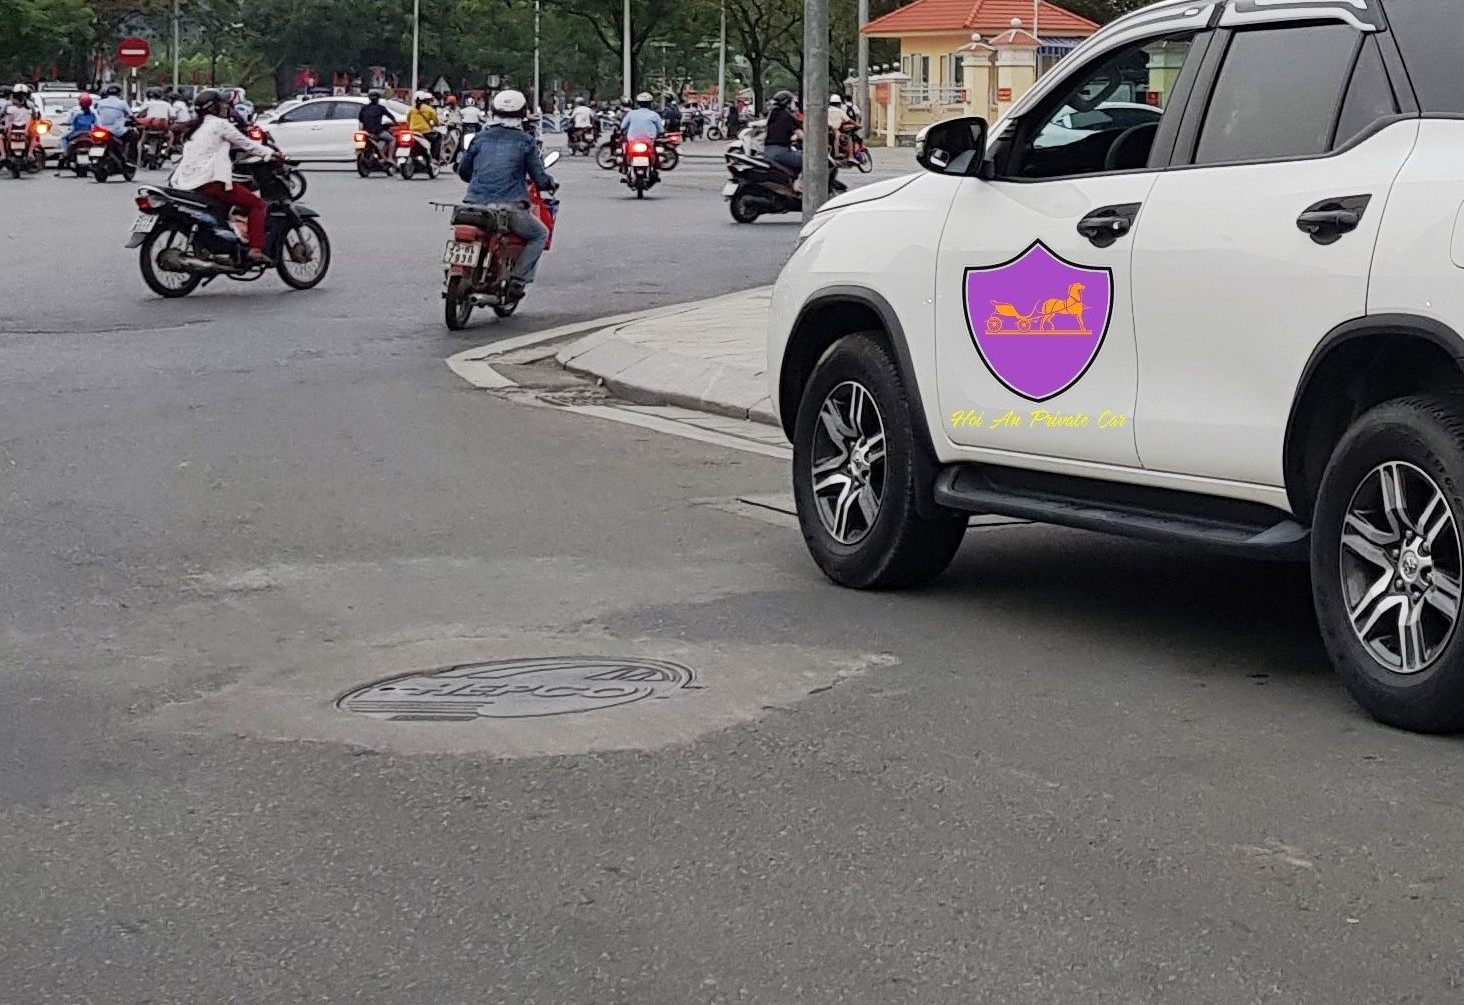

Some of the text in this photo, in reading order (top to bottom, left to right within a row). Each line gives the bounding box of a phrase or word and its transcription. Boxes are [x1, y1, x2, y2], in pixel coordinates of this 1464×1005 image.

[950, 409, 1127, 430] Hoi An Private Car
